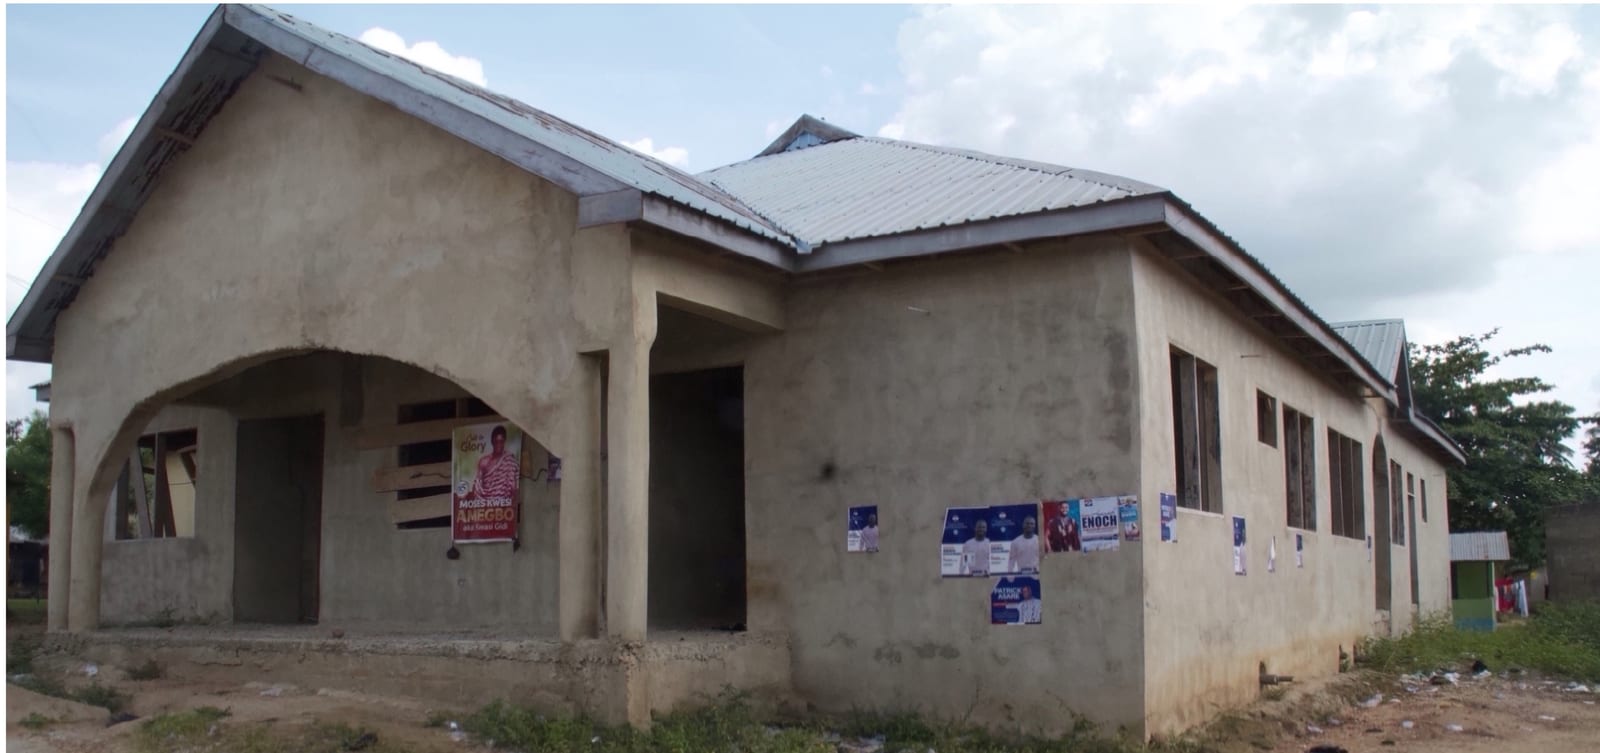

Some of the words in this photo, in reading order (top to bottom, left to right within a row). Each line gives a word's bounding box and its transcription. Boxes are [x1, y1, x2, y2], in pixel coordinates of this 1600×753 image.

[461, 440, 486, 453] Glory
[459, 500, 485, 508] MOSES
[487, 498, 512, 507] KWESI
[457, 508, 514, 523] AMEGBO
[1082, 515, 1117, 528] ENOCH
